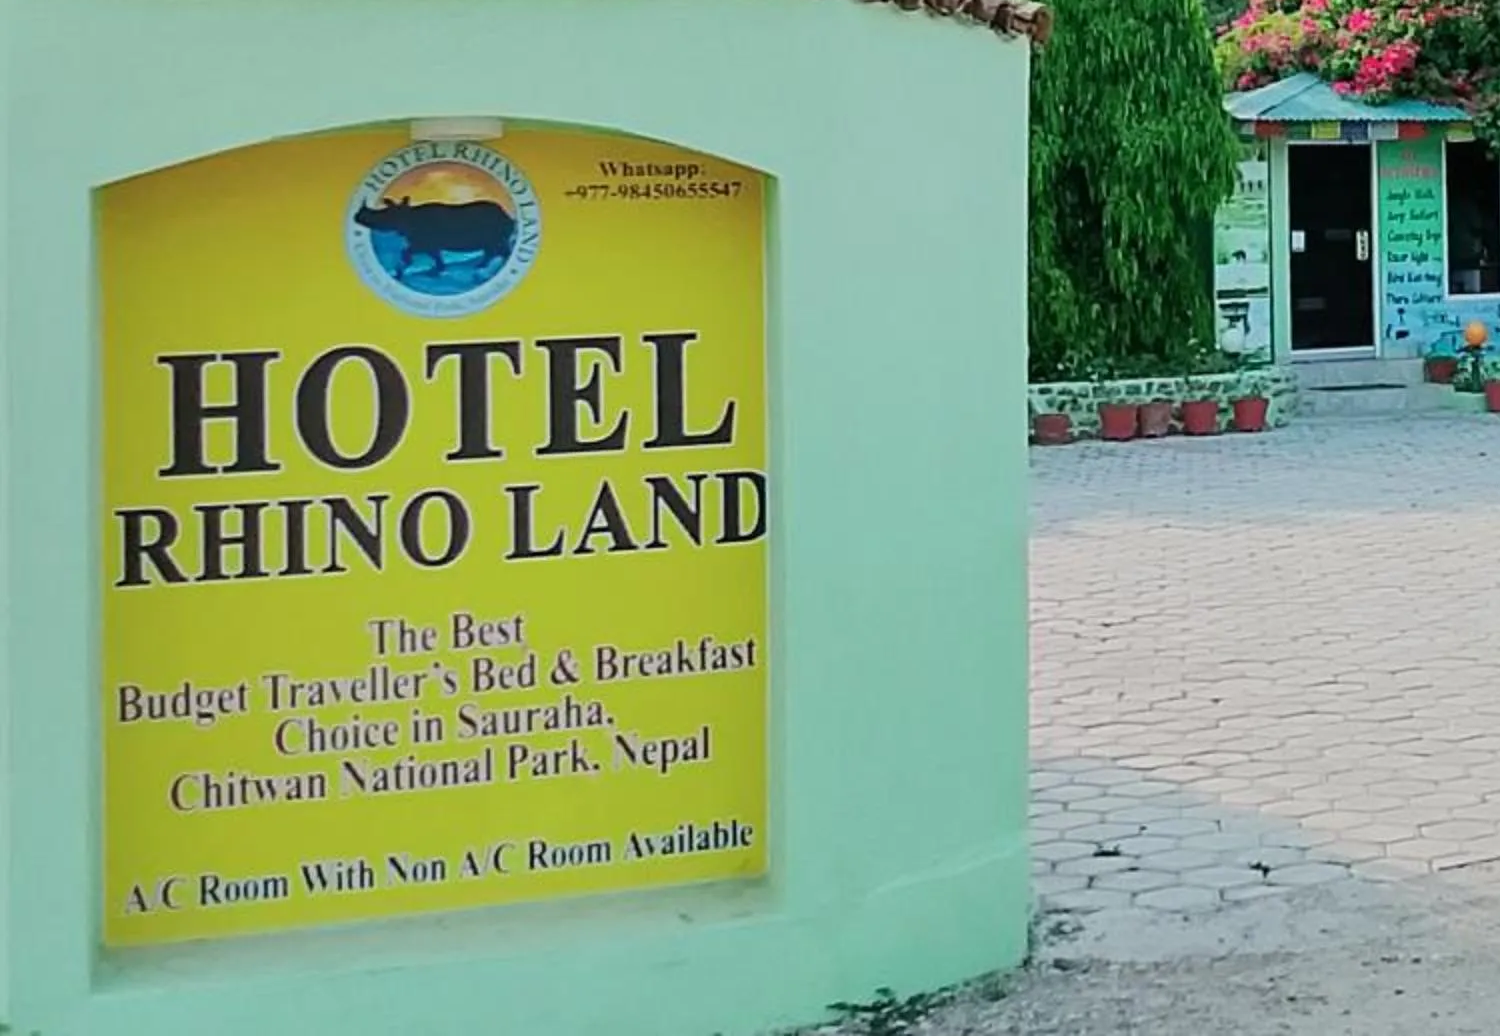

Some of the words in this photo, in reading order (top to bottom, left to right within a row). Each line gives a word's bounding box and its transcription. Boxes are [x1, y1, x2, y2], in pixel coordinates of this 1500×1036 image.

[364, 143, 449, 192] HOTEL
[452, 143, 528, 196] RHINO
[518, 200, 539, 264] LAND
[157, 333, 735, 477] HOTEL
[113, 489, 472, 588] RHINO
[504, 470, 767, 561] LAND
[368, 619, 437, 655] The
[452, 613, 525, 649] Best
[118, 681, 250, 728] Budget
[261, 661, 458, 711] Traveller's
[472, 654, 537, 692] Bed
[550, 649, 580, 685] &
[596, 636, 756, 681] Breakfast
[170, 771, 328, 812] Chitwan
[340, 747, 493, 796] National
[613, 726, 711, 774] Nepal
[274, 716, 400, 755] Choice
[412, 709, 444, 743] in
[199, 875, 289, 907] Room
[300, 860, 376, 892] With
[387, 855, 447, 884] Non
[458, 843, 516, 877] A/C
[528, 840, 612, 870] Room
[623, 820, 754, 860] Available
